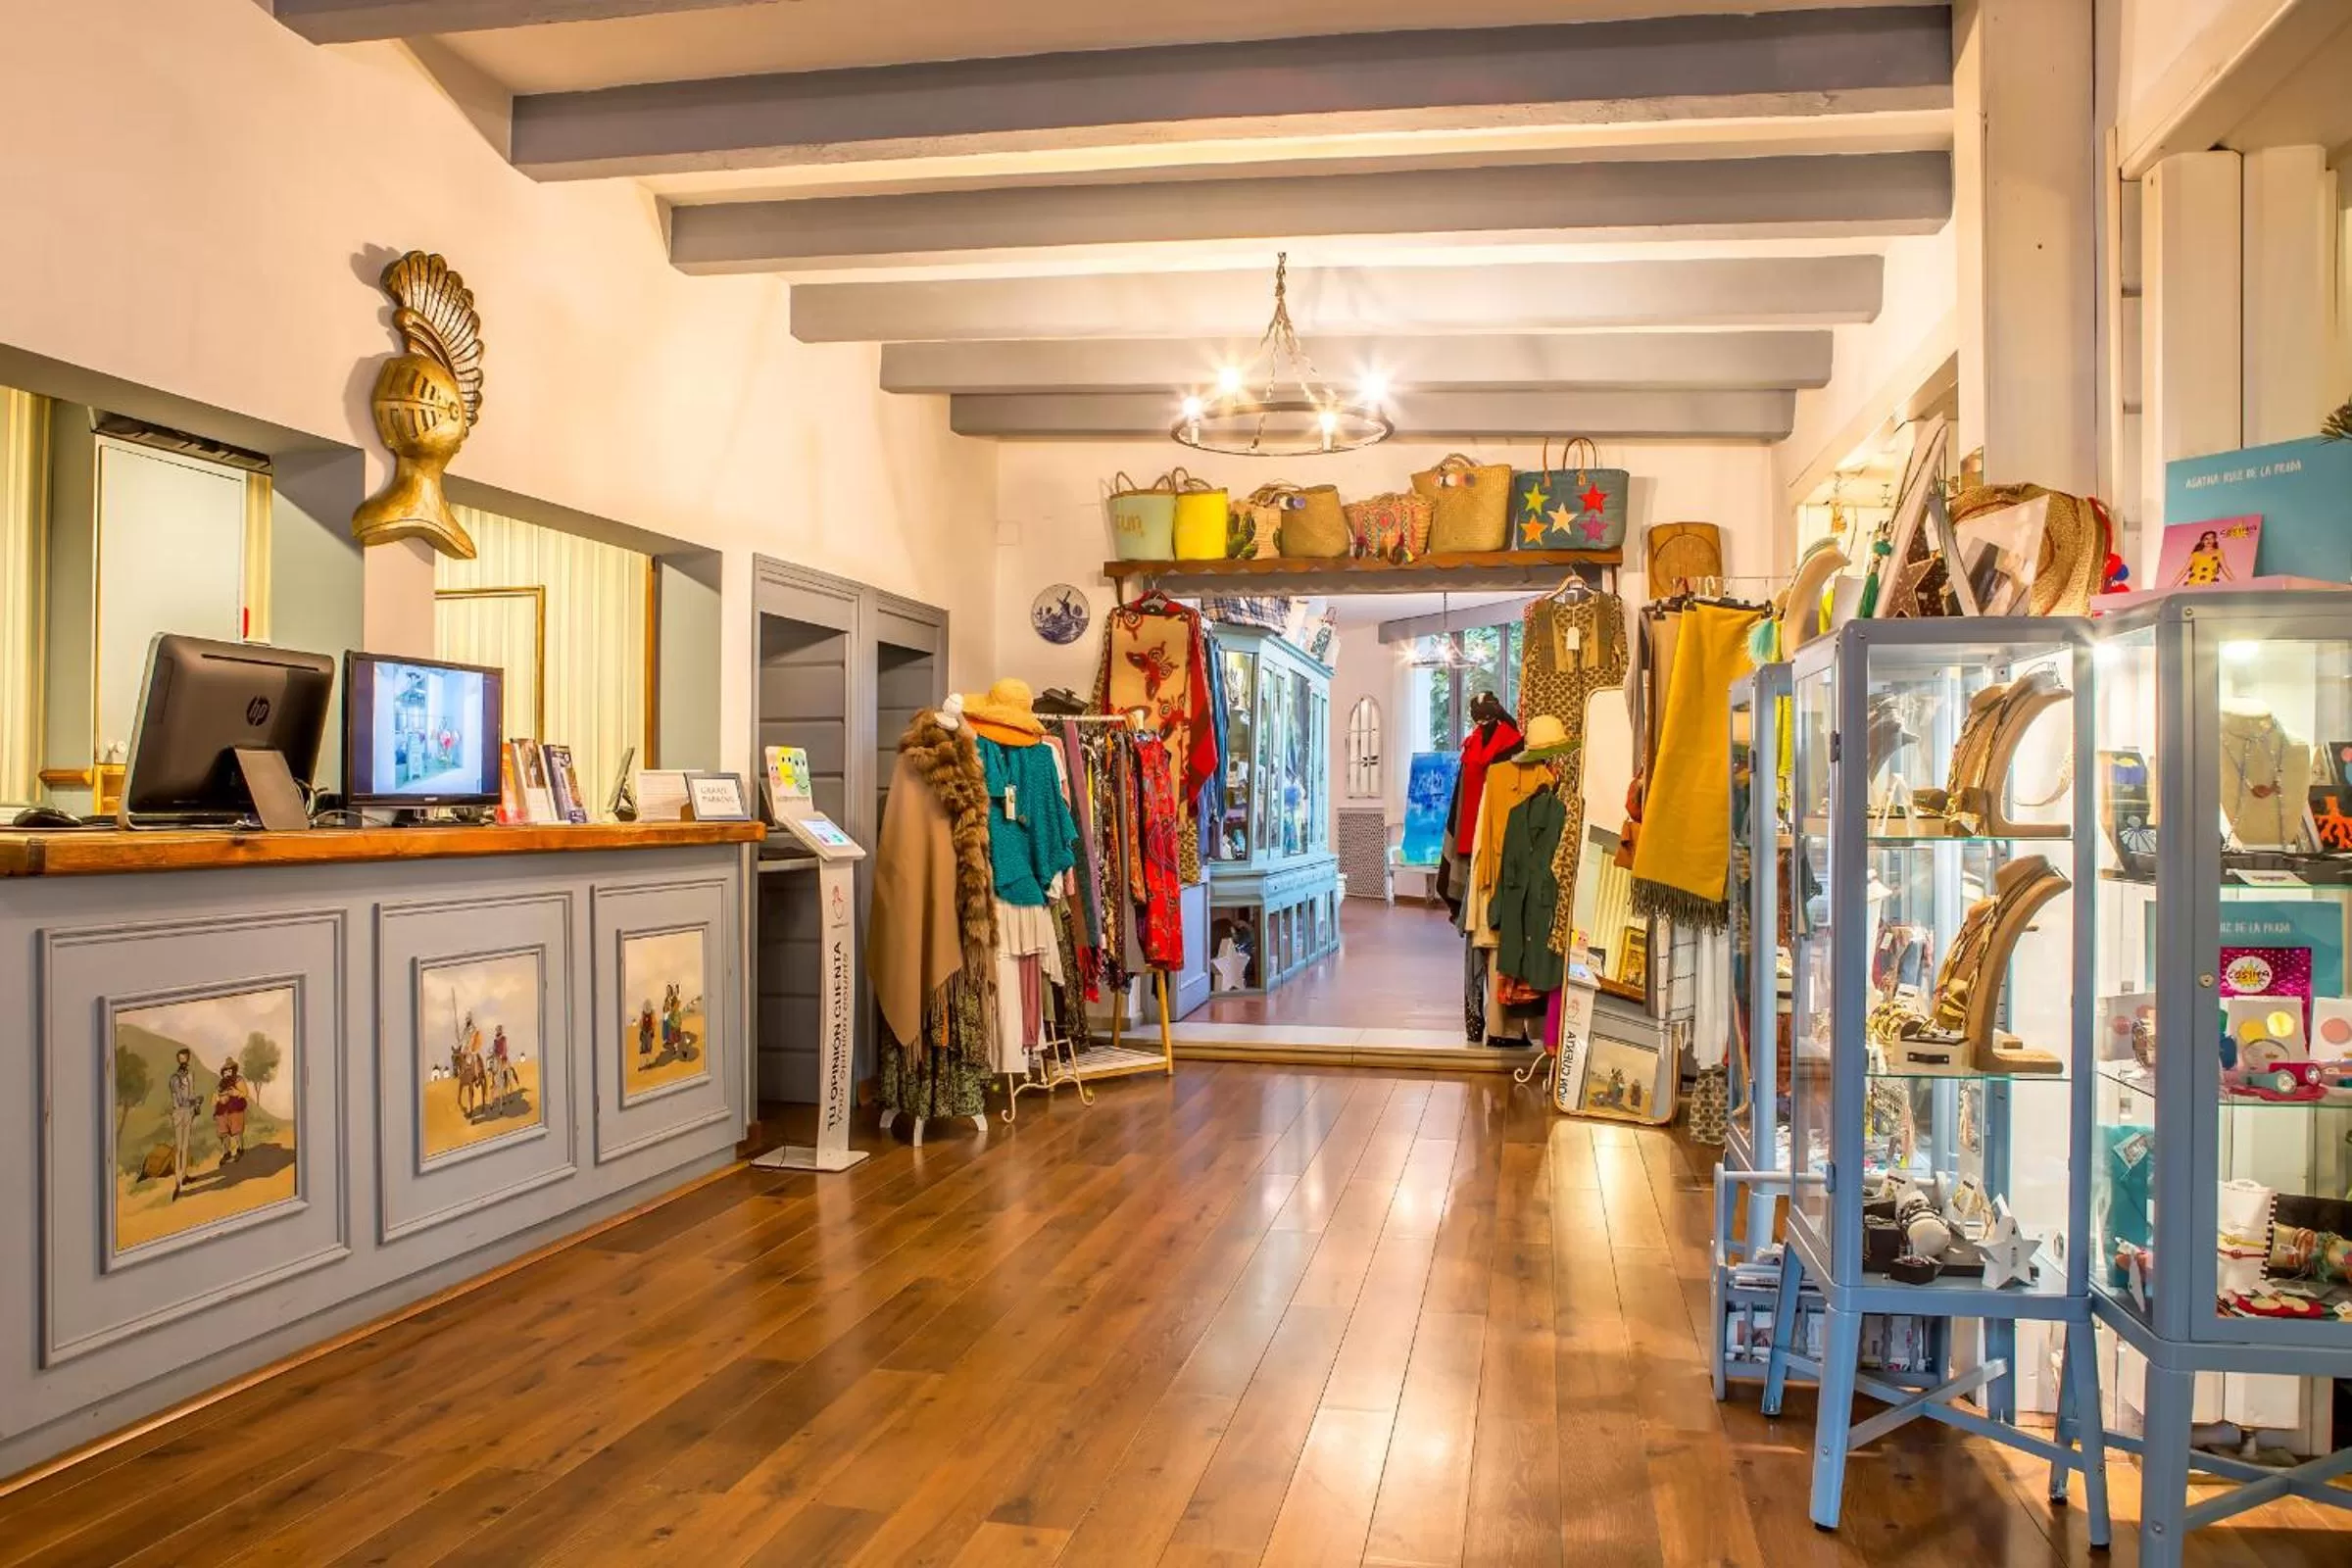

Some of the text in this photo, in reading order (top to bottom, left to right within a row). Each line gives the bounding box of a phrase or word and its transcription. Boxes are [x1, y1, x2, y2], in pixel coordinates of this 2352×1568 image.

[2185, 460, 2302, 490] AGATHA RUIZ DE LA PRADA
[247, 695, 270, 726] hp
[827, 1105, 837, 1133] TU
[833, 941, 842, 1019] CUENTA
